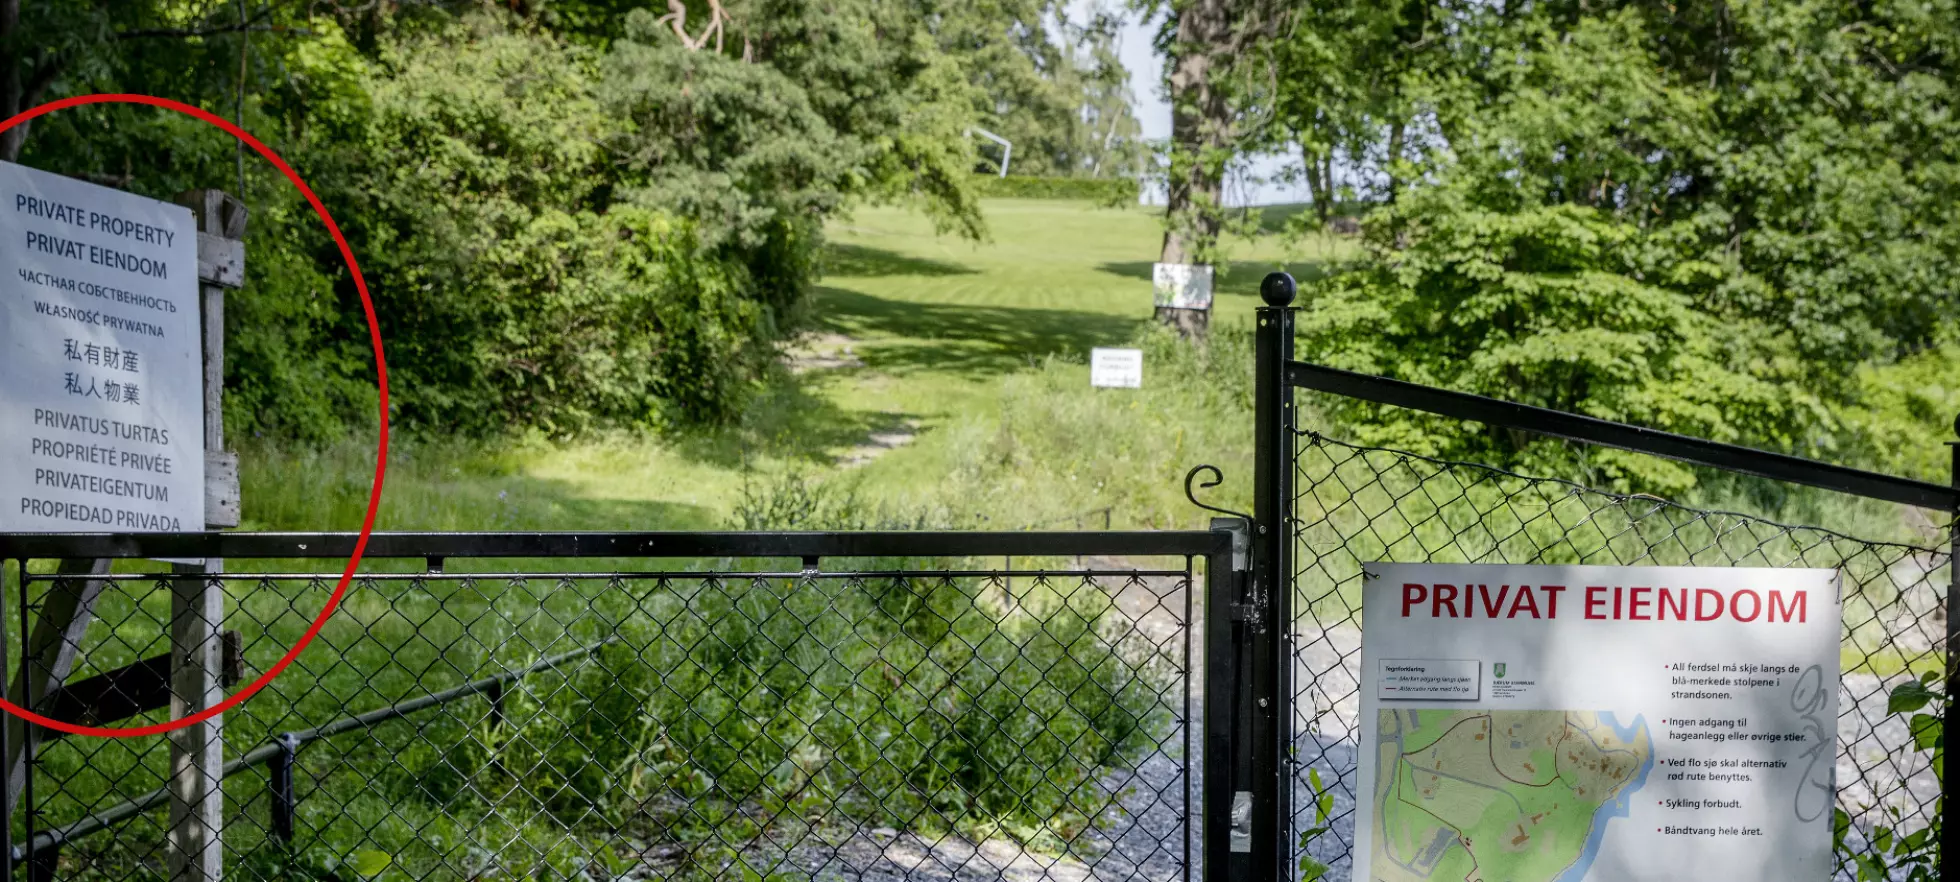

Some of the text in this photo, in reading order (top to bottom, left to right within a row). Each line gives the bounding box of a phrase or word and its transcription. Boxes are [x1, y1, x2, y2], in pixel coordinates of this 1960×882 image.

[16, 193, 175, 248] PRIVATE PROPERTY
[26, 231, 167, 280] PRIVAT EIENDOM
[18, 268, 176, 313] ЧАСТНАЯ СОБСТВЕННОСТЬ
[34, 300, 164, 338] WŁASNOŚĆ PRYWATNA
[63, 338, 139, 373] 私有財産
[64, 372, 141, 406] 私人物業
[34, 408, 169, 445] PRIVATUS TURTAS
[32, 437, 171, 475] PROPRIÉTÉ PRIVÉE
[35, 468, 169, 502] PRIVATEIGENTUM
[21, 497, 181, 532] PROPIEDAD PRIVADA
[1401, 583, 1807, 623] PRIVAT EIENDOM
[1672, 663, 1800, 674] All ferdsel må skje langs de
[1673, 676, 1731, 686] blå-merkede
[1734, 677, 1774, 688] stolpene
[1671, 691, 1733, 701] strandsonen.
[1669, 718, 1748, 729] Ingen adgang til
[1669, 732, 1807, 743] hageanlegg eller øvrige stier.
[1667, 758, 1788, 770] Ved flo sjø skal alternativ
[1667, 772, 1753, 784] rød rute benyttes.
[1666, 798, 1742, 810] Sykling forbudt.
[1665, 826, 1763, 837] Båndtvang hele året.
